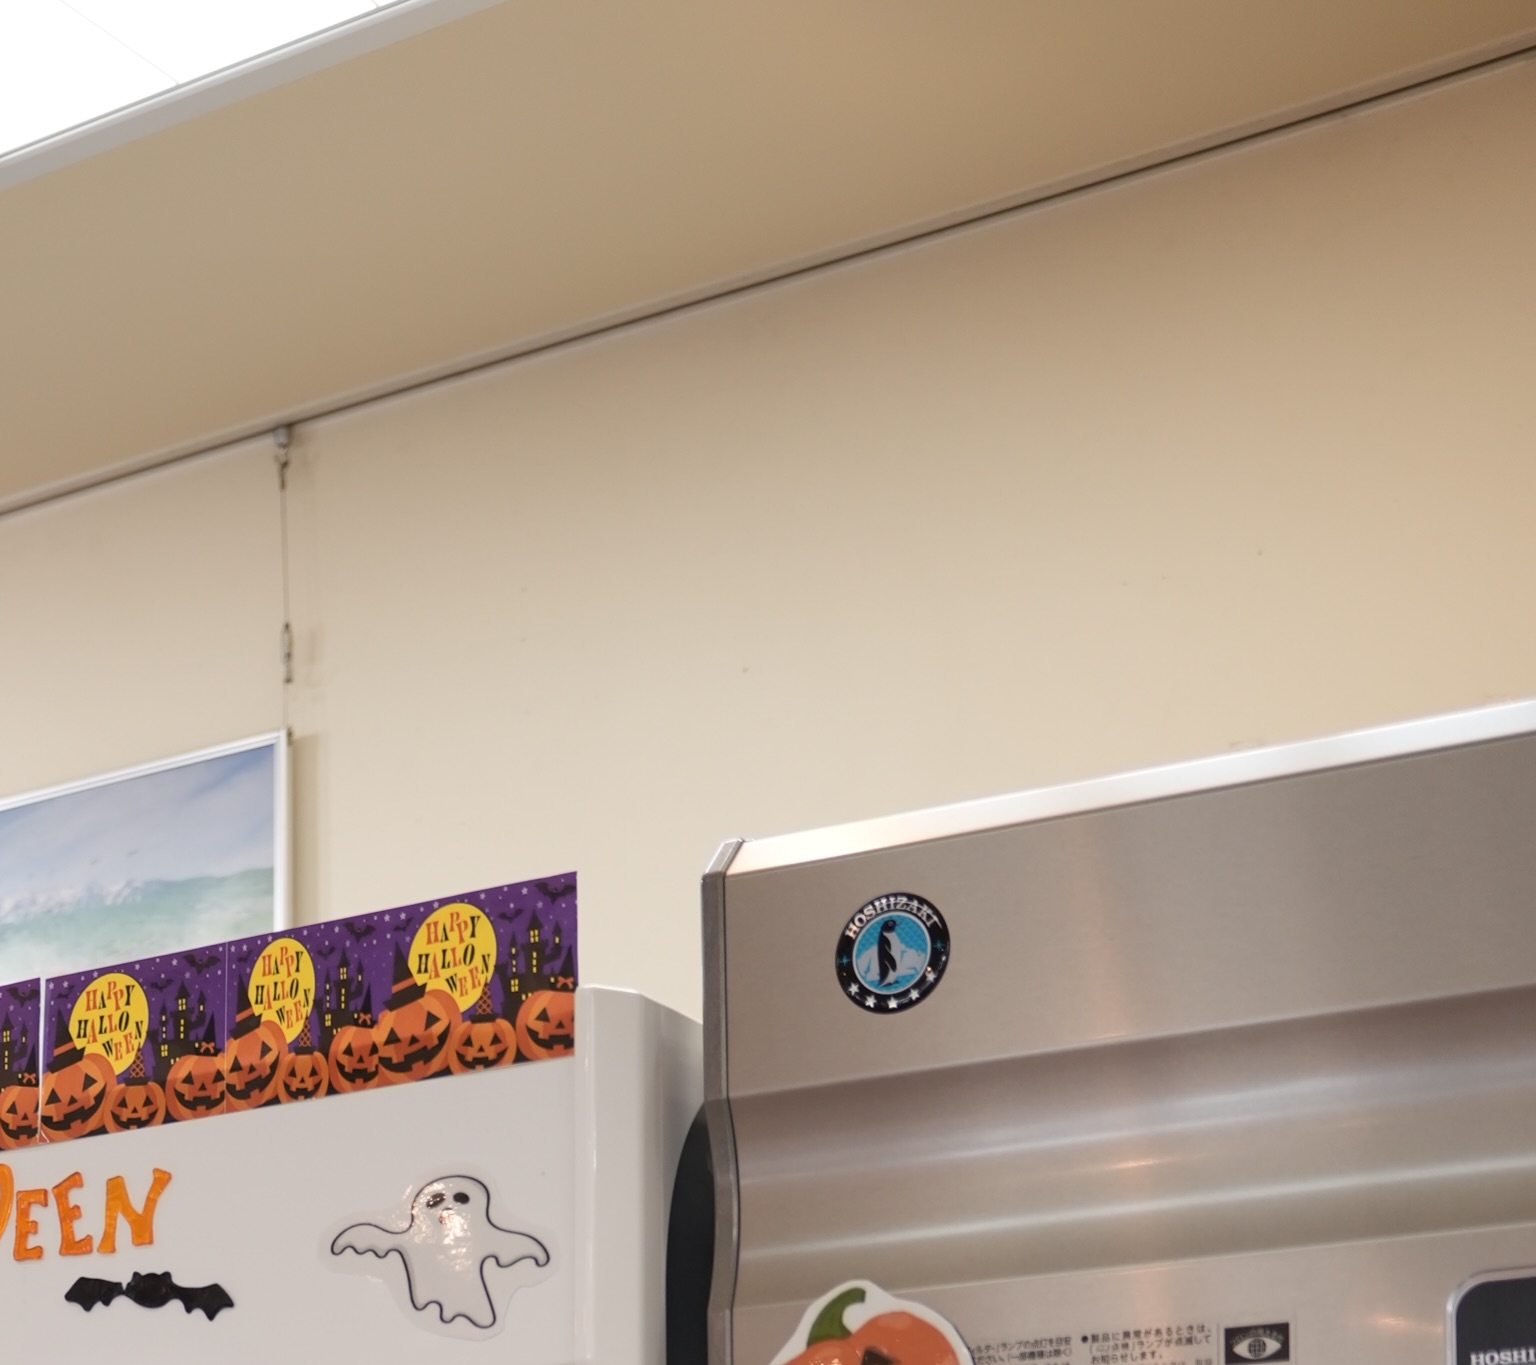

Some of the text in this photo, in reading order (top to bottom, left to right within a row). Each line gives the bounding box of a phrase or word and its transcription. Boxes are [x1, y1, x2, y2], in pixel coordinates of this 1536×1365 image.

[425, 911, 480, 944] HAPPY
[845, 896, 942, 939] HOSHIZAKI
[262, 947, 303, 977] HAPPY
[85, 981, 135, 1011] HAPPY
